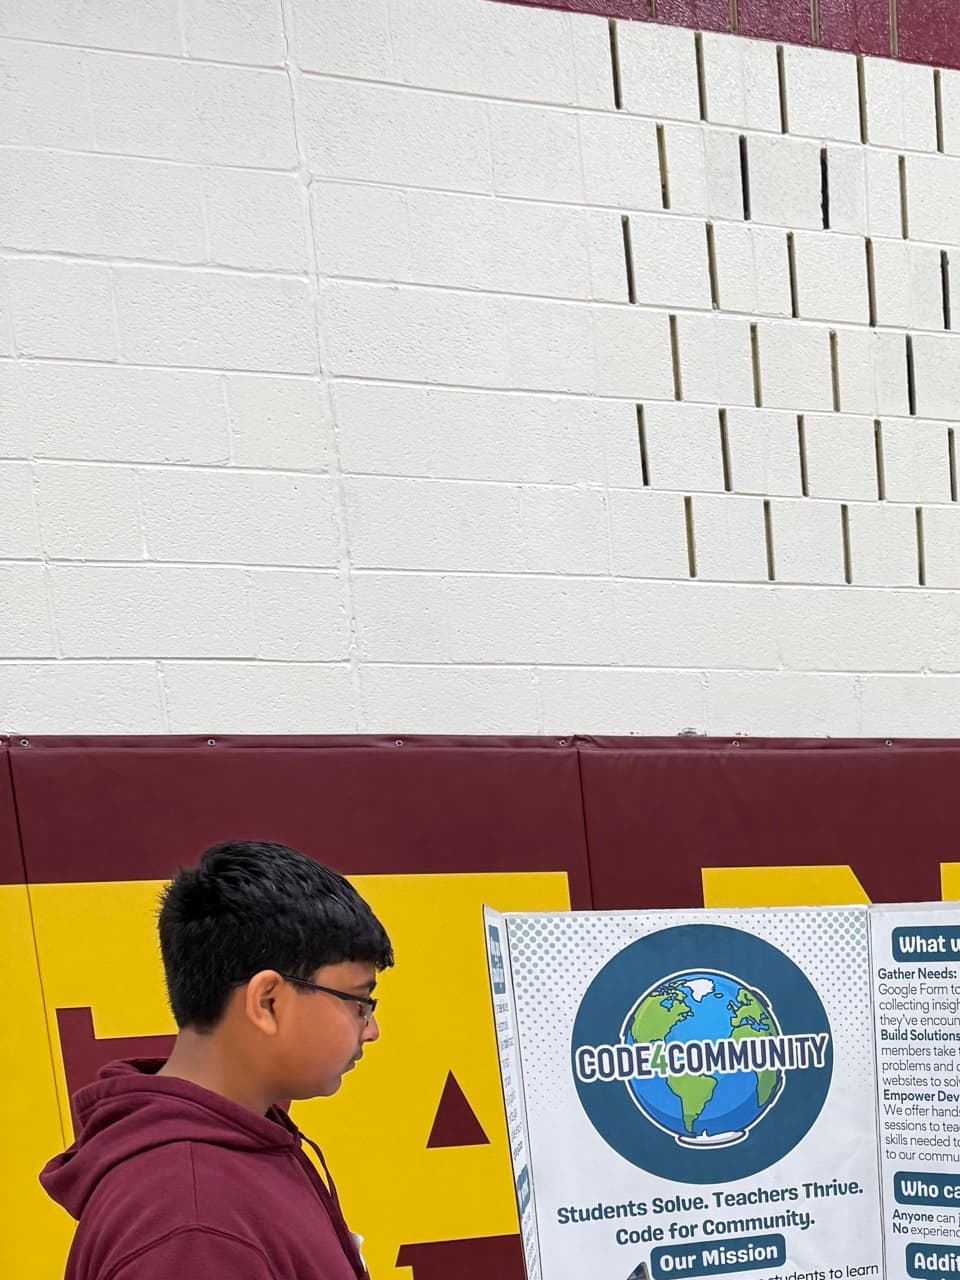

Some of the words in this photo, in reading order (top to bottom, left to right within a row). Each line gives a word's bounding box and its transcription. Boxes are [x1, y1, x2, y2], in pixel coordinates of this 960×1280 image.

[899, 935, 946, 953] What
[878, 967, 915, 980] Gather
[918, 967, 957, 979] Needs:
[878, 983, 917, 998] Google
[919, 983, 948, 995] Form
[879, 998, 930, 1013] collecting
[879, 1014, 918, 1029] they've
[881, 1029, 908, 1041] Build
[577, 1034, 828, 1081] CODE4COMMUNITY
[881, 1044, 931, 1057] members
[933, 1045, 956, 1057] take
[882, 1059, 931, 1073] problems
[933, 1059, 954, 1072] and
[882, 1074, 928, 1087] websites
[930, 1076, 941, 1087] to
[883, 1089, 935, 1104] Empower
[883, 1103, 903, 1116] We
[904, 1104, 929, 1116] offer
[884, 1119, 927, 1131] sessions
[929, 1120, 940, 1131] to
[885, 1133, 908, 1146] skills
[910, 1135, 951, 1147] needed
[885, 1149, 897, 1160] to
[898, 1150, 916, 1161] our
[900, 1180, 939, 1197] Who
[557, 1200, 647, 1224] Students
[652, 1196, 709, 1214] Solve.
[712, 1186, 798, 1208] Teachers
[802, 1179, 864, 1199] Thrive.
[892, 1209, 934, 1224] Anyone
[936, 1213, 956, 1224] can
[616, 1225, 664, 1245] Code
[668, 1220, 698, 1239] for
[702, 1210, 815, 1236] Community.
[892, 1222, 909, 1234] No
[659, 1253, 696, 1272] Our
[702, 1244, 778, 1267] Mission
[828, 1268, 843, 1280] to
[846, 1263, 879, 1278] learn
